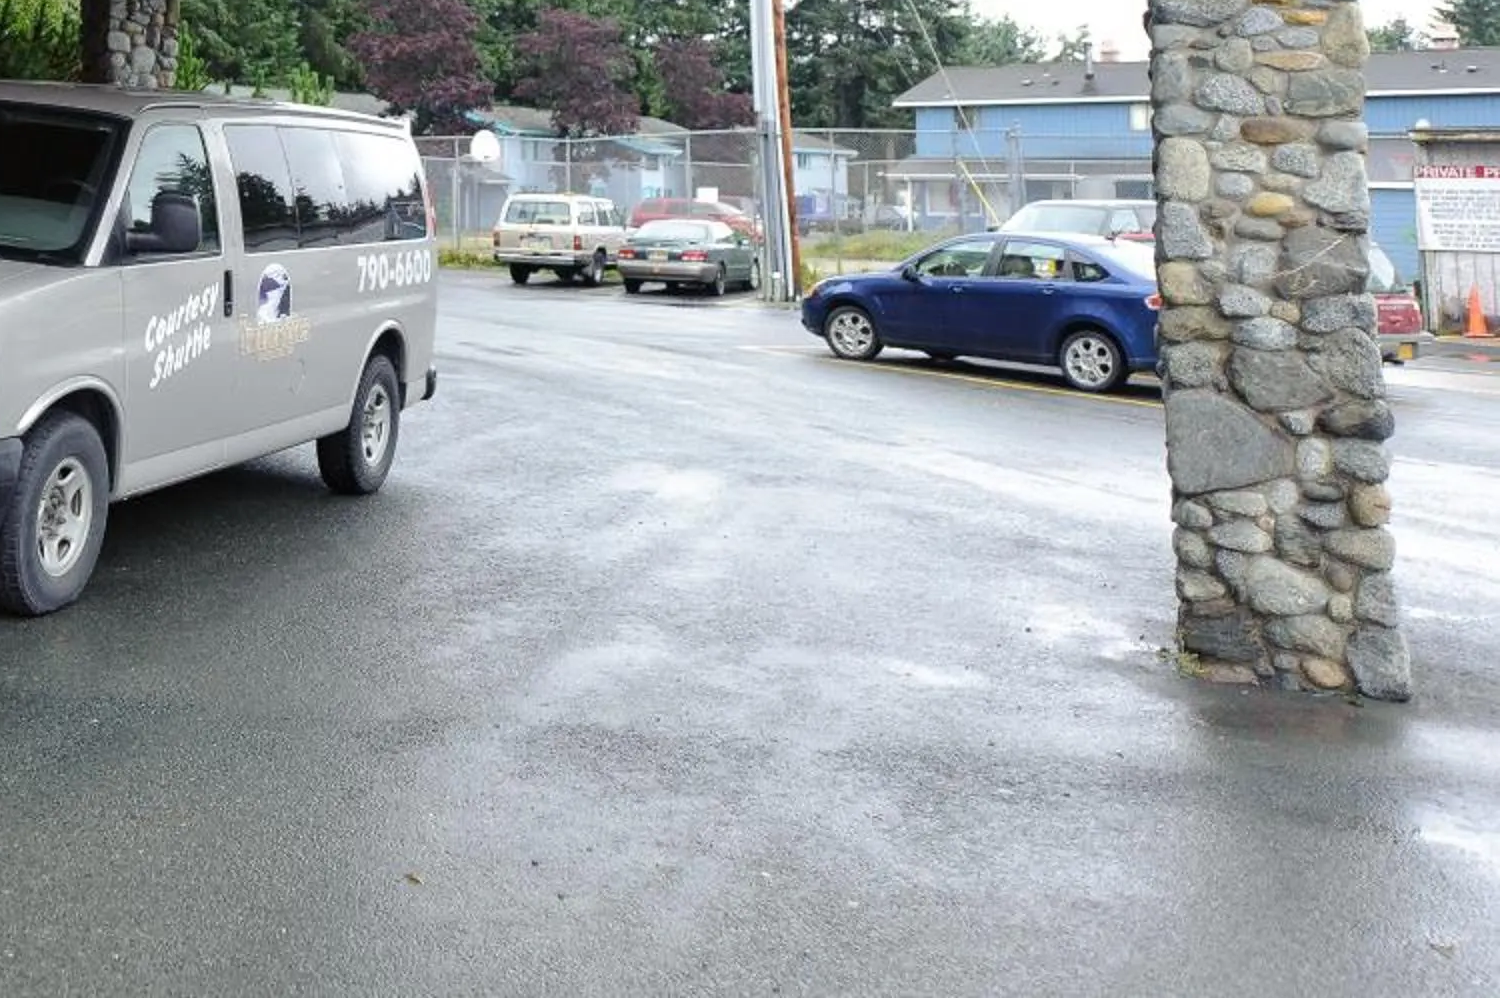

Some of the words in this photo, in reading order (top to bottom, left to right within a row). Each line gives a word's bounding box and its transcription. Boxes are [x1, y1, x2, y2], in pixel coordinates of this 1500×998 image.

[1414, 165, 1476, 178] PRIVATE
[357, 249, 432, 293] 790-6600
[145, 281, 220, 352] Courtesy
[149, 321, 212, 389] Shuttle
